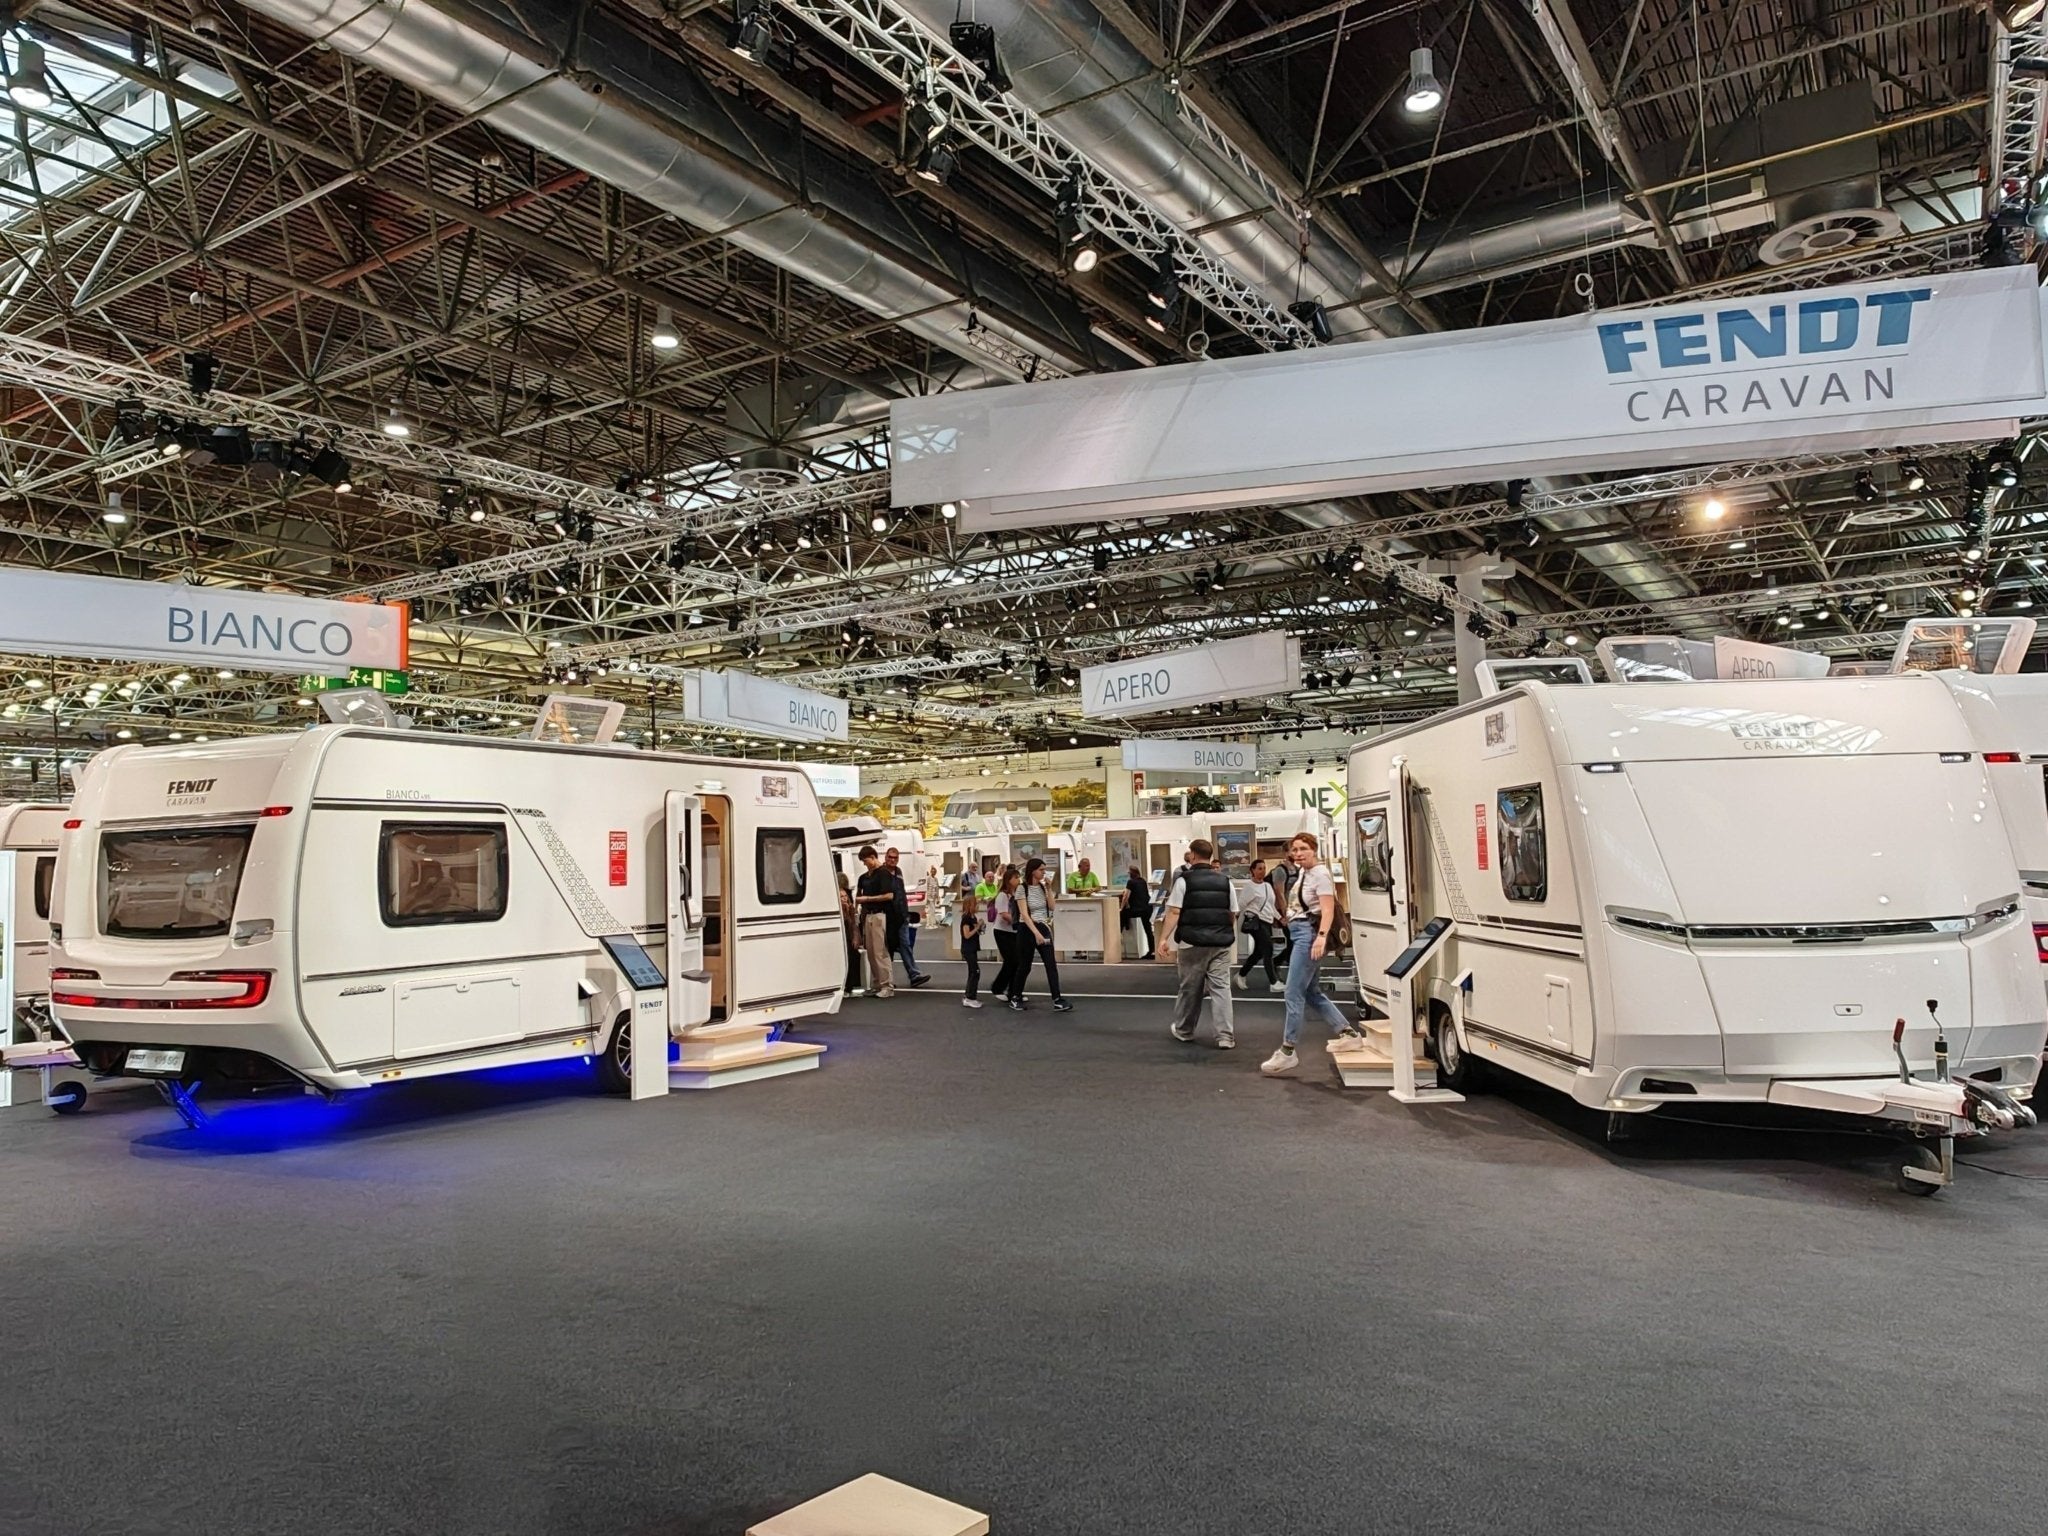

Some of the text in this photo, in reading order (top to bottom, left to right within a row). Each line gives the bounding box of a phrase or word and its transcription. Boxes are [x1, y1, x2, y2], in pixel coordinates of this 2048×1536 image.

[1597, 288, 1932, 374] FENDT
[1627, 367, 1895, 422] CARAVAN
[168, 607, 352, 656] BIANCO
[1732, 656, 1776, 679] APERO
[1102, 669, 1171, 704] APERO
[789, 700, 837, 732] BIANCO
[1729, 721, 1817, 738] FENDT
[1194, 750, 1244, 767] BIANCO
[167, 779, 218, 795] FENDT
[386, 789, 420, 800] BIANCO
[166, 796, 207, 807] CARAVAN
[610, 841, 627, 851] 2025
[343, 984, 384, 996] selection
[640, 1000, 663, 1010] FENDT
